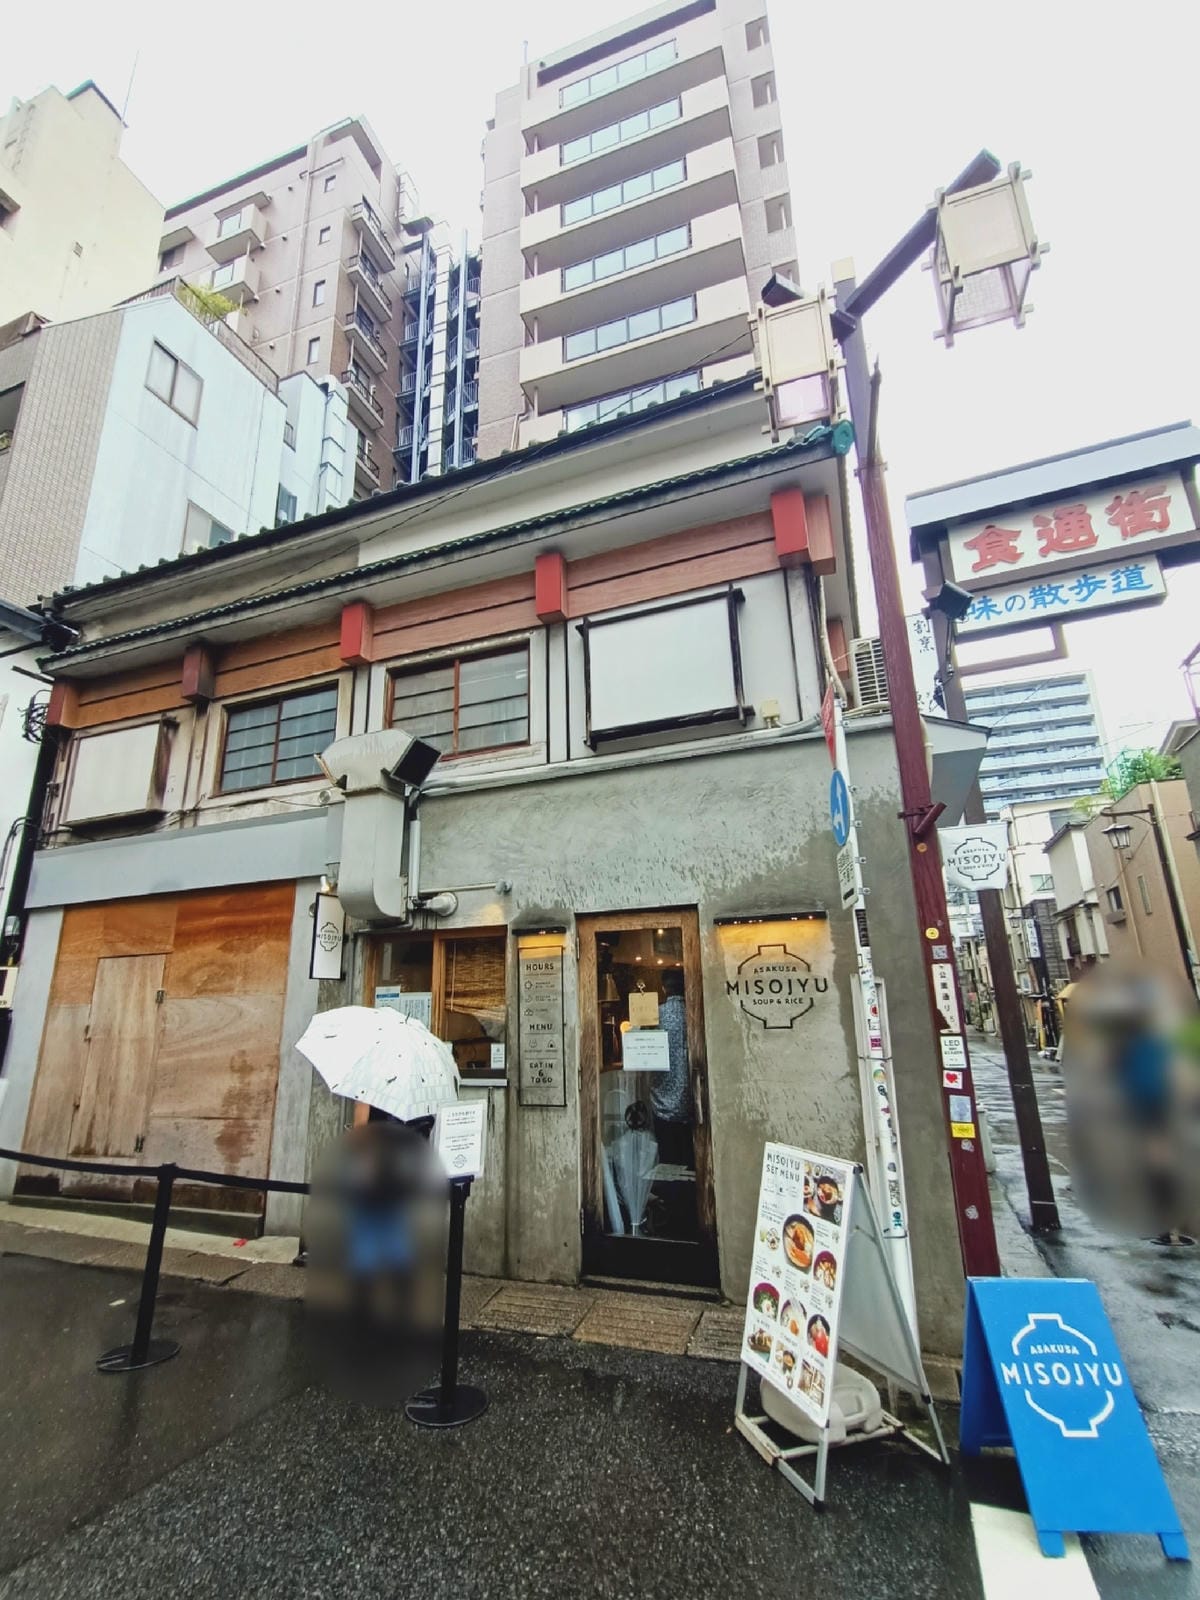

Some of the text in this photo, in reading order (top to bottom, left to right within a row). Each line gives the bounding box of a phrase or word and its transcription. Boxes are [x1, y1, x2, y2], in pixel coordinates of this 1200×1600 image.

[963, 485, 1172, 573] 食通街
[967, 564, 1153, 621] 味の散歩道
[947, 853, 1006, 867] MISOJYU
[526, 963, 554, 971] HOURS
[753, 965, 798, 974] ASAKUSA
[726, 978, 829, 996] MISOJYU
[752, 998, 775, 1006] SOUP
[785, 997, 804, 1005] RICE
[529, 1023, 553, 1031] MENU
[529, 1062, 544, 1070] EAT
[531, 1076, 553, 1084] TO GO
[766, 1163, 780, 1177] SET
[1029, 1343, 1081, 1355] ASAKUSA
[1000, 1362, 1123, 1387] MISOJYU
